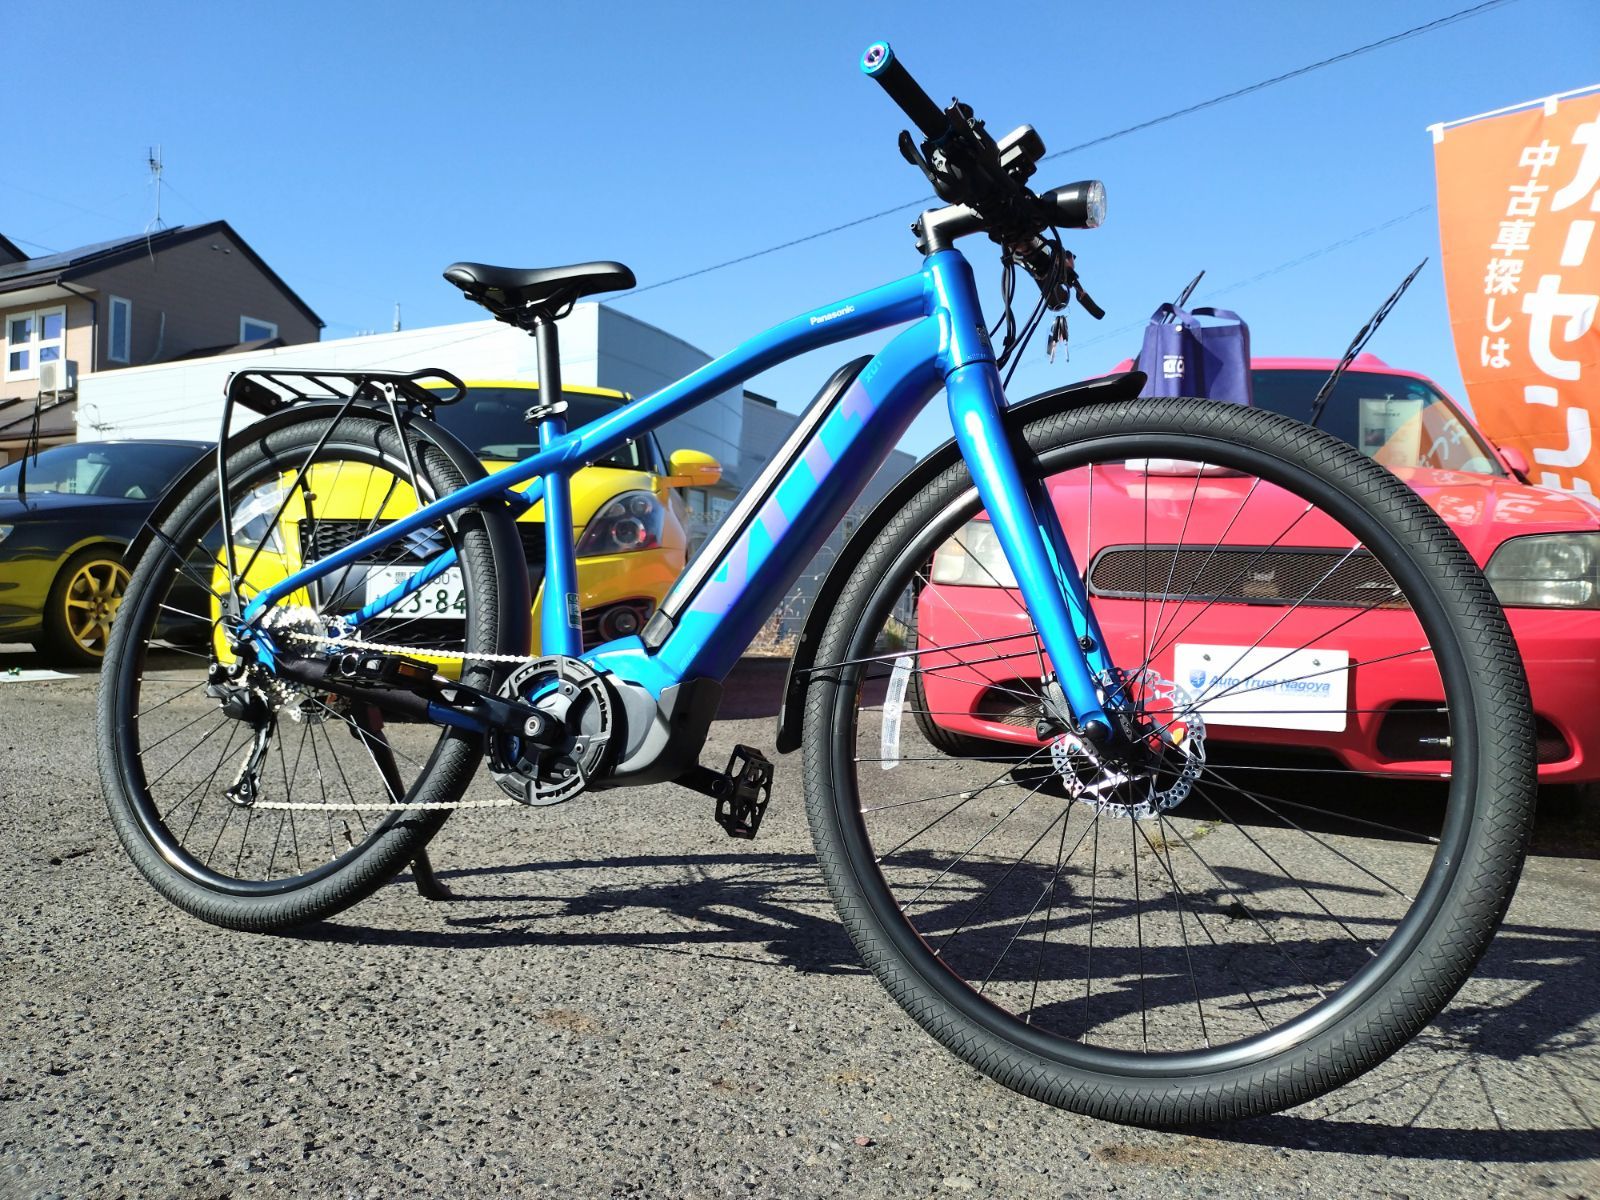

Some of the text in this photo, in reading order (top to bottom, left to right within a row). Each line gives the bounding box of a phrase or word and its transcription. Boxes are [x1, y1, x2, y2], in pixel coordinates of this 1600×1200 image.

[1481, 139, 1561, 369] 中古車探しは
[810, 304, 856, 326] Panasonic
[1522, 112, 1600, 506] カーセン
[390, 589, 466, 615] 3-84
[1208, 675, 1331, 693] Auto Trust Nagoya
